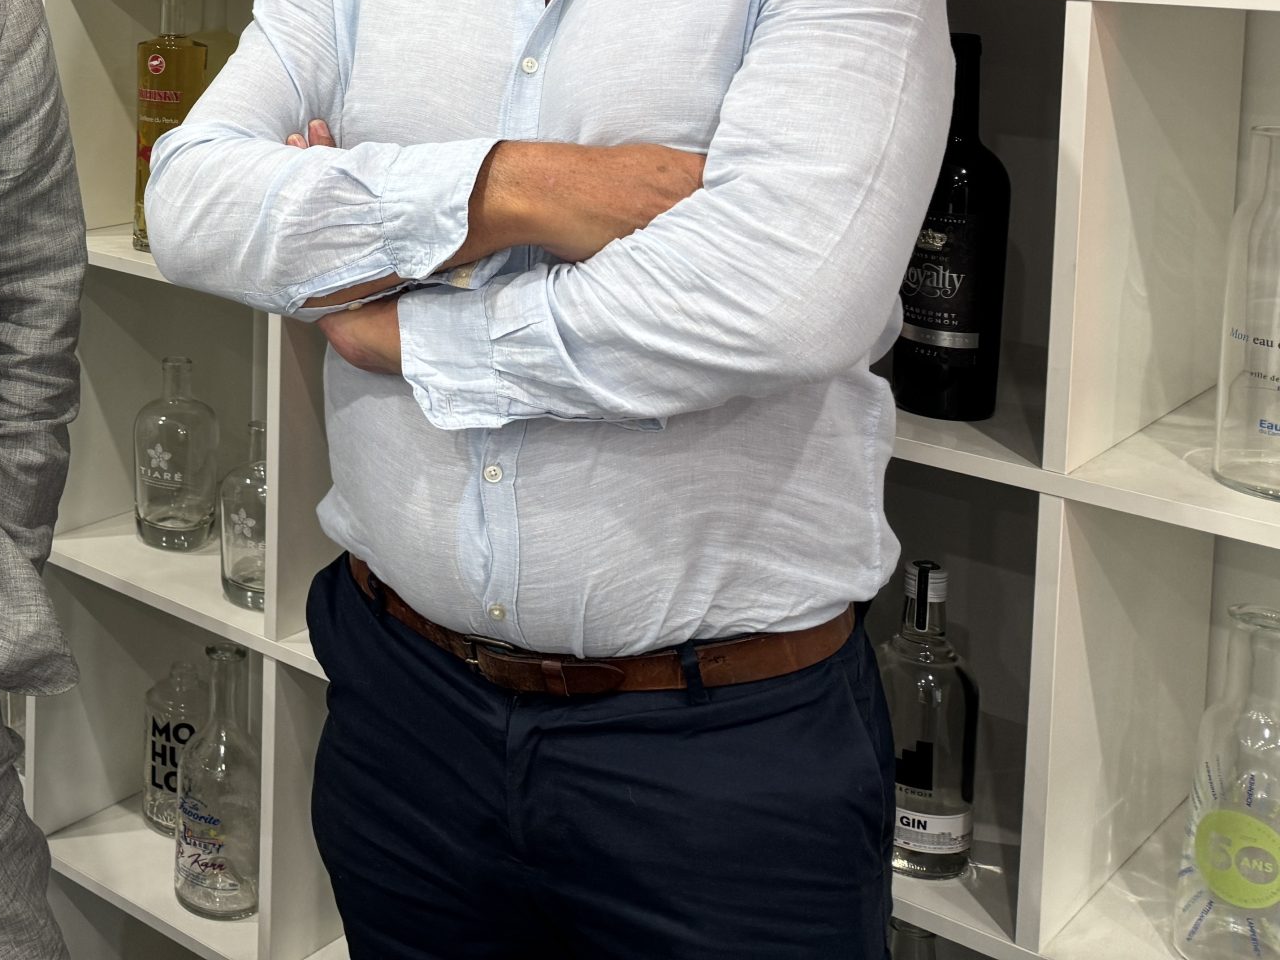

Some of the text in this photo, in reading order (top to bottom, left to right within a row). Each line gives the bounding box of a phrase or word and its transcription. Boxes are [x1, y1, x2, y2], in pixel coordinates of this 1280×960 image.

[905, 312, 959, 326] AUVIGNON
[1230, 327, 1274, 348] Mon eau
[899, 815, 928, 831] GIN
[1240, 857, 1274, 873] ANS
